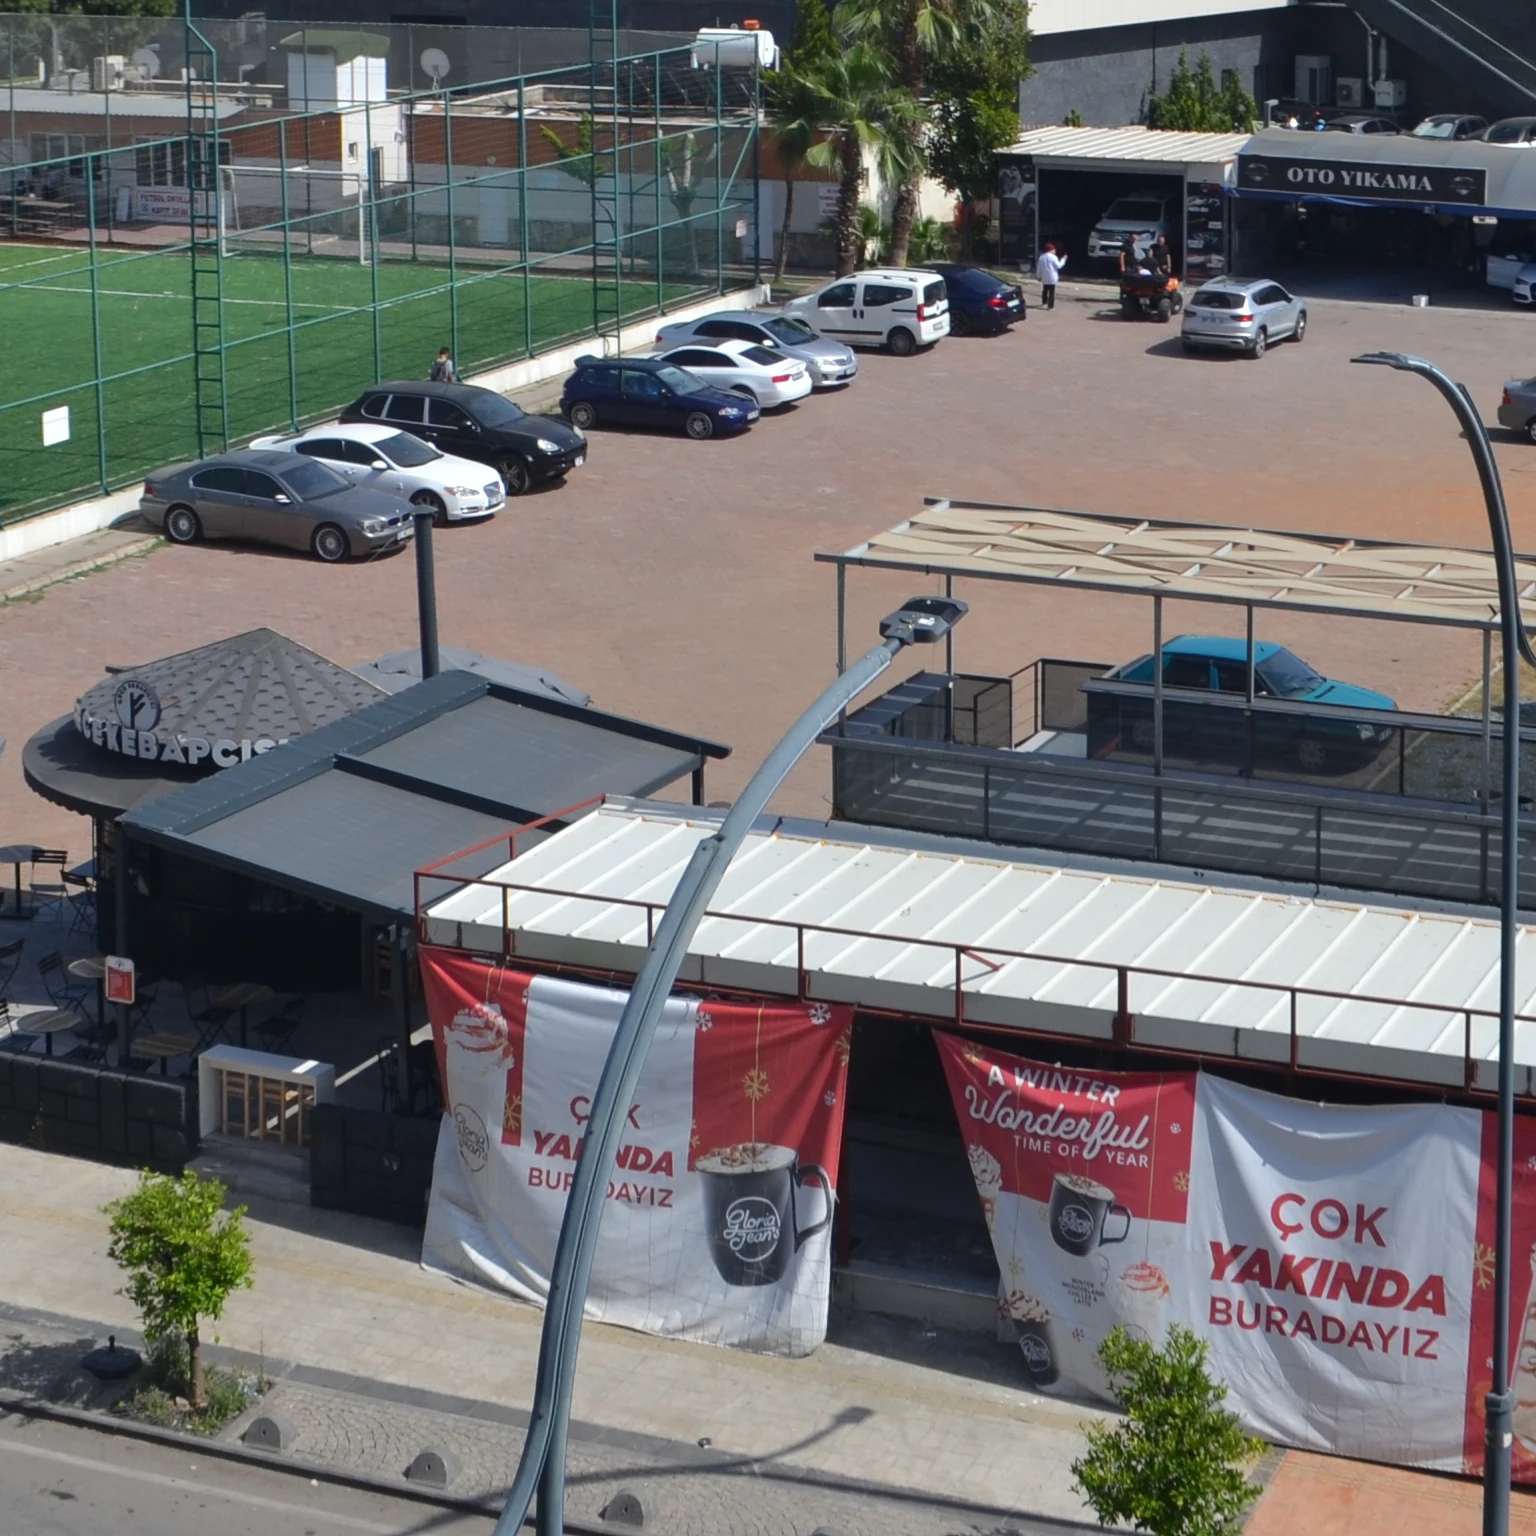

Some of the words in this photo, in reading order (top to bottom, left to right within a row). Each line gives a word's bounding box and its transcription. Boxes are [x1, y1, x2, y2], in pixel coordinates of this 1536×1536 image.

[1287, 167, 1335, 184] OTO
[1341, 170, 1433, 192] YIKAMA
[987, 1065, 1005, 1086] A
[1014, 1066, 1121, 1107] WINTER
[570, 1096, 641, 1130] ÇK
[965, 1085, 1149, 1160] Wonderful
[533, 1130, 674, 1177] YANDA
[1014, 1135, 1052, 1154] TIME
[1058, 1143, 1080, 1158] OF
[1105, 1149, 1149, 1168] YEAR
[528, 1167, 674, 1208] BURDAYIZ
[724, 1209, 776, 1235] Gloria
[1270, 1192, 1388, 1248] ÇOK
[1209, 1240, 1447, 1316] YAKINDA
[1209, 1296, 1440, 1360] BURADAYIZ
